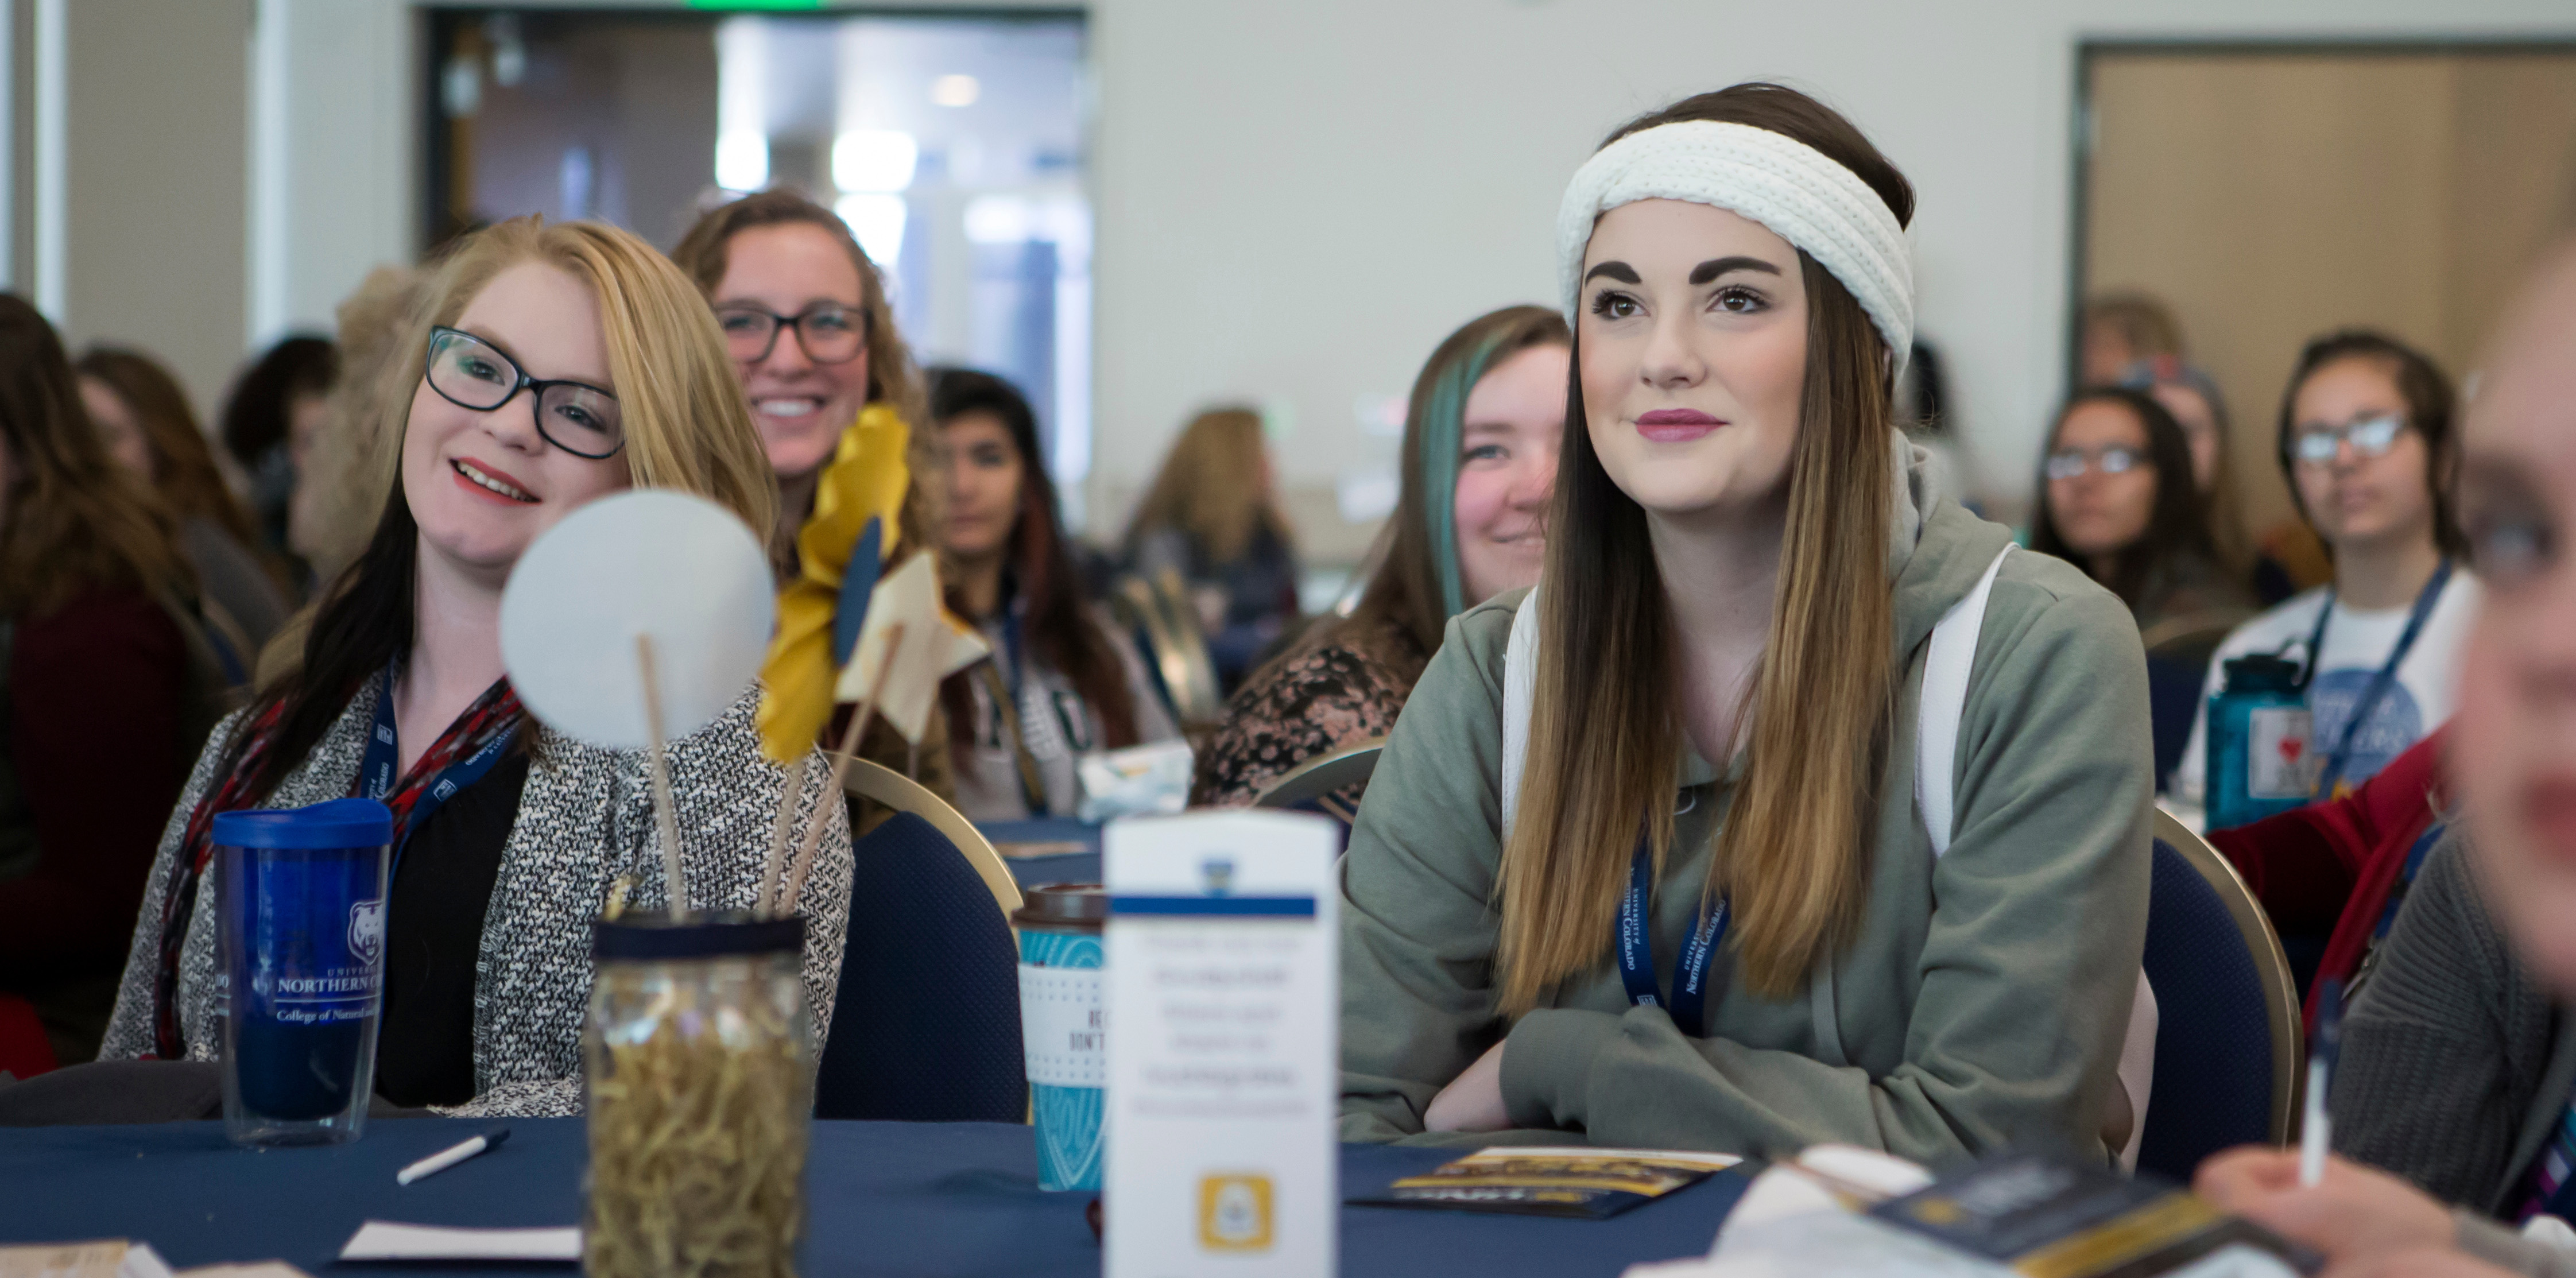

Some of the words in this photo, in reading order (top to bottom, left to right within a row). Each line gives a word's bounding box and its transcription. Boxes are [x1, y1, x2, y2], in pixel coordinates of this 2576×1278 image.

[1623, 917, 1636, 970] COLORADO
[1686, 946, 1706, 995] NORTHERN
[1699, 900, 1726, 946] COLORADO
[277, 977, 368, 993] NORTHERN
[276, 1009, 317, 1025] College
[319, 1009, 333, 1021] of
